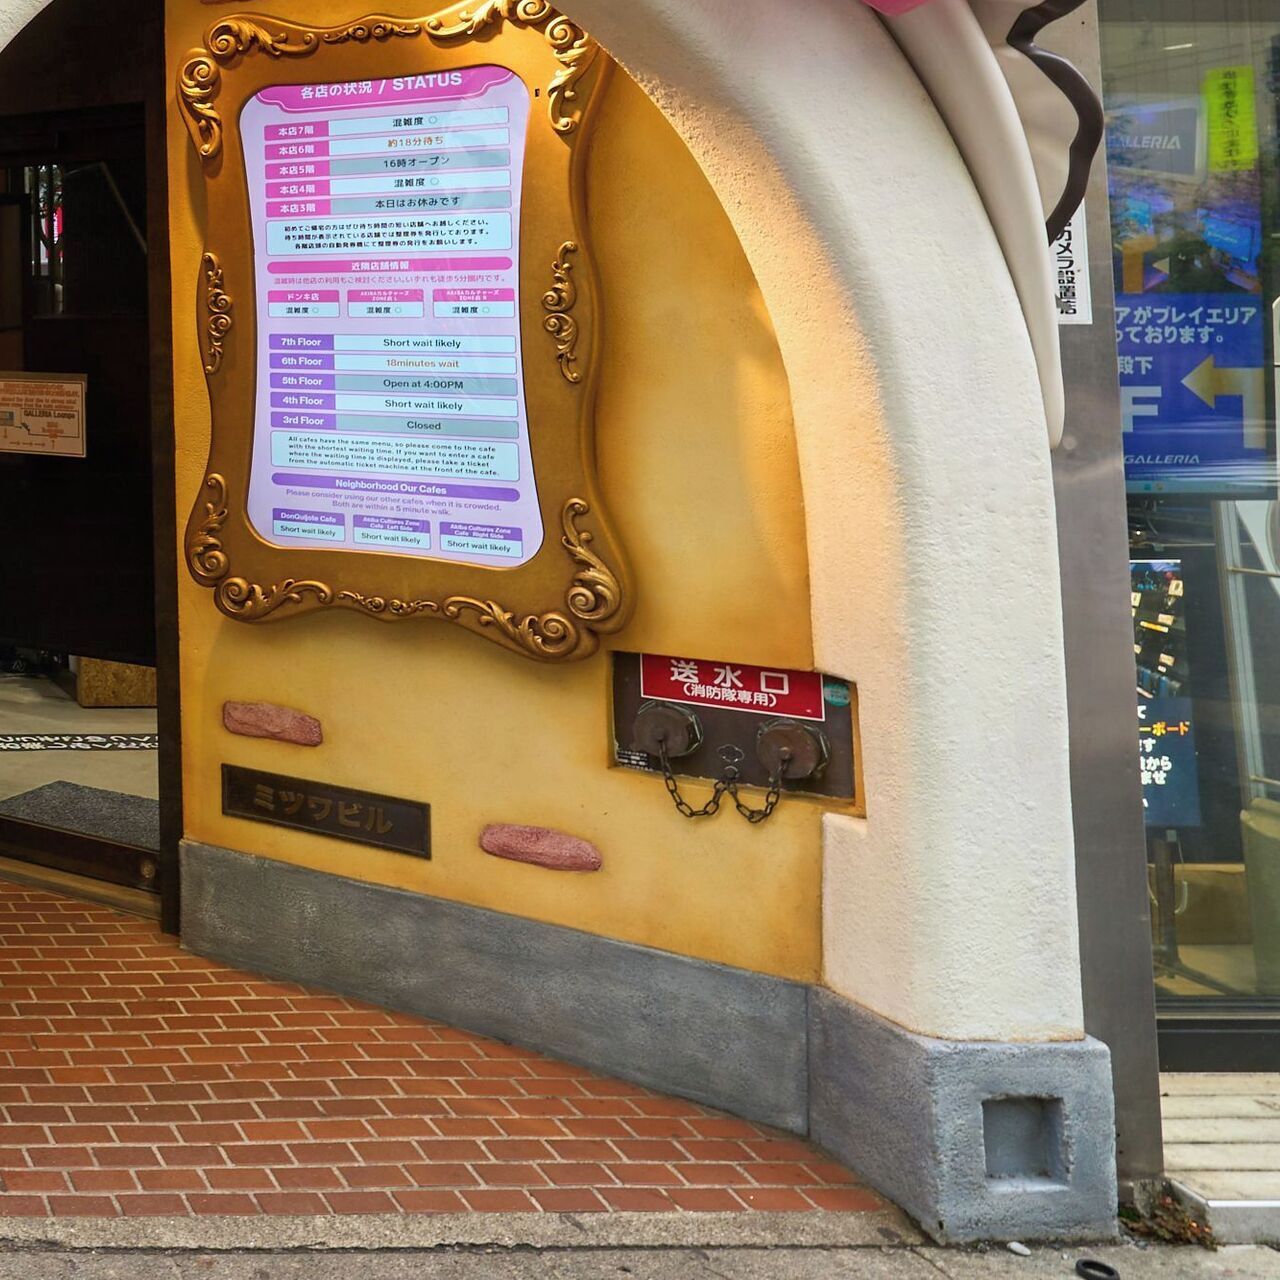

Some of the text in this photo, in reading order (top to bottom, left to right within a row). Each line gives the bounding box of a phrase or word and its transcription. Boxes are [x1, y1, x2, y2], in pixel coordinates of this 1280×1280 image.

[300, 81, 373, 100] 各店の状況
[391, 73, 463, 91] STATUS
[277, 125, 314, 136] 本店7階
[278, 145, 315, 155] 本店6階
[383, 155, 450, 169] 16時オープン
[279, 165, 315, 175] 本店5階
[279, 184, 316, 194] 本店4階
[279, 203, 316, 213] 本店3階
[375, 196, 460, 209] 本日はお休みです
[287, 293, 320, 301] ドンキ店
[281, 338, 321, 346] 7th Floor
[383, 338, 461, 349] Short wait likely
[281, 357, 322, 366] 6th Floor
[386, 359, 459, 368] 18minutes wait
[282, 377, 323, 386] 5th Floor
[383, 379, 464, 390] Open at 4:00PM
[282, 396, 323, 405] 4th Floor
[384, 399, 463, 411] Short wait likely
[282, 416, 324, 425] 3rd Floor
[407, 421, 441, 430] Closed
[1124, 454, 1200, 464] GALLERIA
[335, 479, 447, 495] Neighborhood Our Cafes
[286, 489, 310, 497] Please
[311, 490, 342, 499] consider
[344, 493, 364, 502] using
[379, 496, 400, 504] other
[402, 497, 424, 506] cafes
[425, 499, 447, 507] when
[463, 501, 502, 512] crowded.
[332, 500, 350, 508] Both
[365, 502, 388, 511] within
[403, 506, 430, 514] minute
[280, 525, 299, 533] Short
[317, 528, 336, 537] likely
[361, 532, 382, 540] Short
[400, 536, 421, 544] likely
[447, 540, 469, 548] Short
[489, 543, 511, 553] likely
[670, 659, 789, 695] 送水口
[1140, 756, 1173, 772] から
[254, 783, 393, 834] ミツワビル
